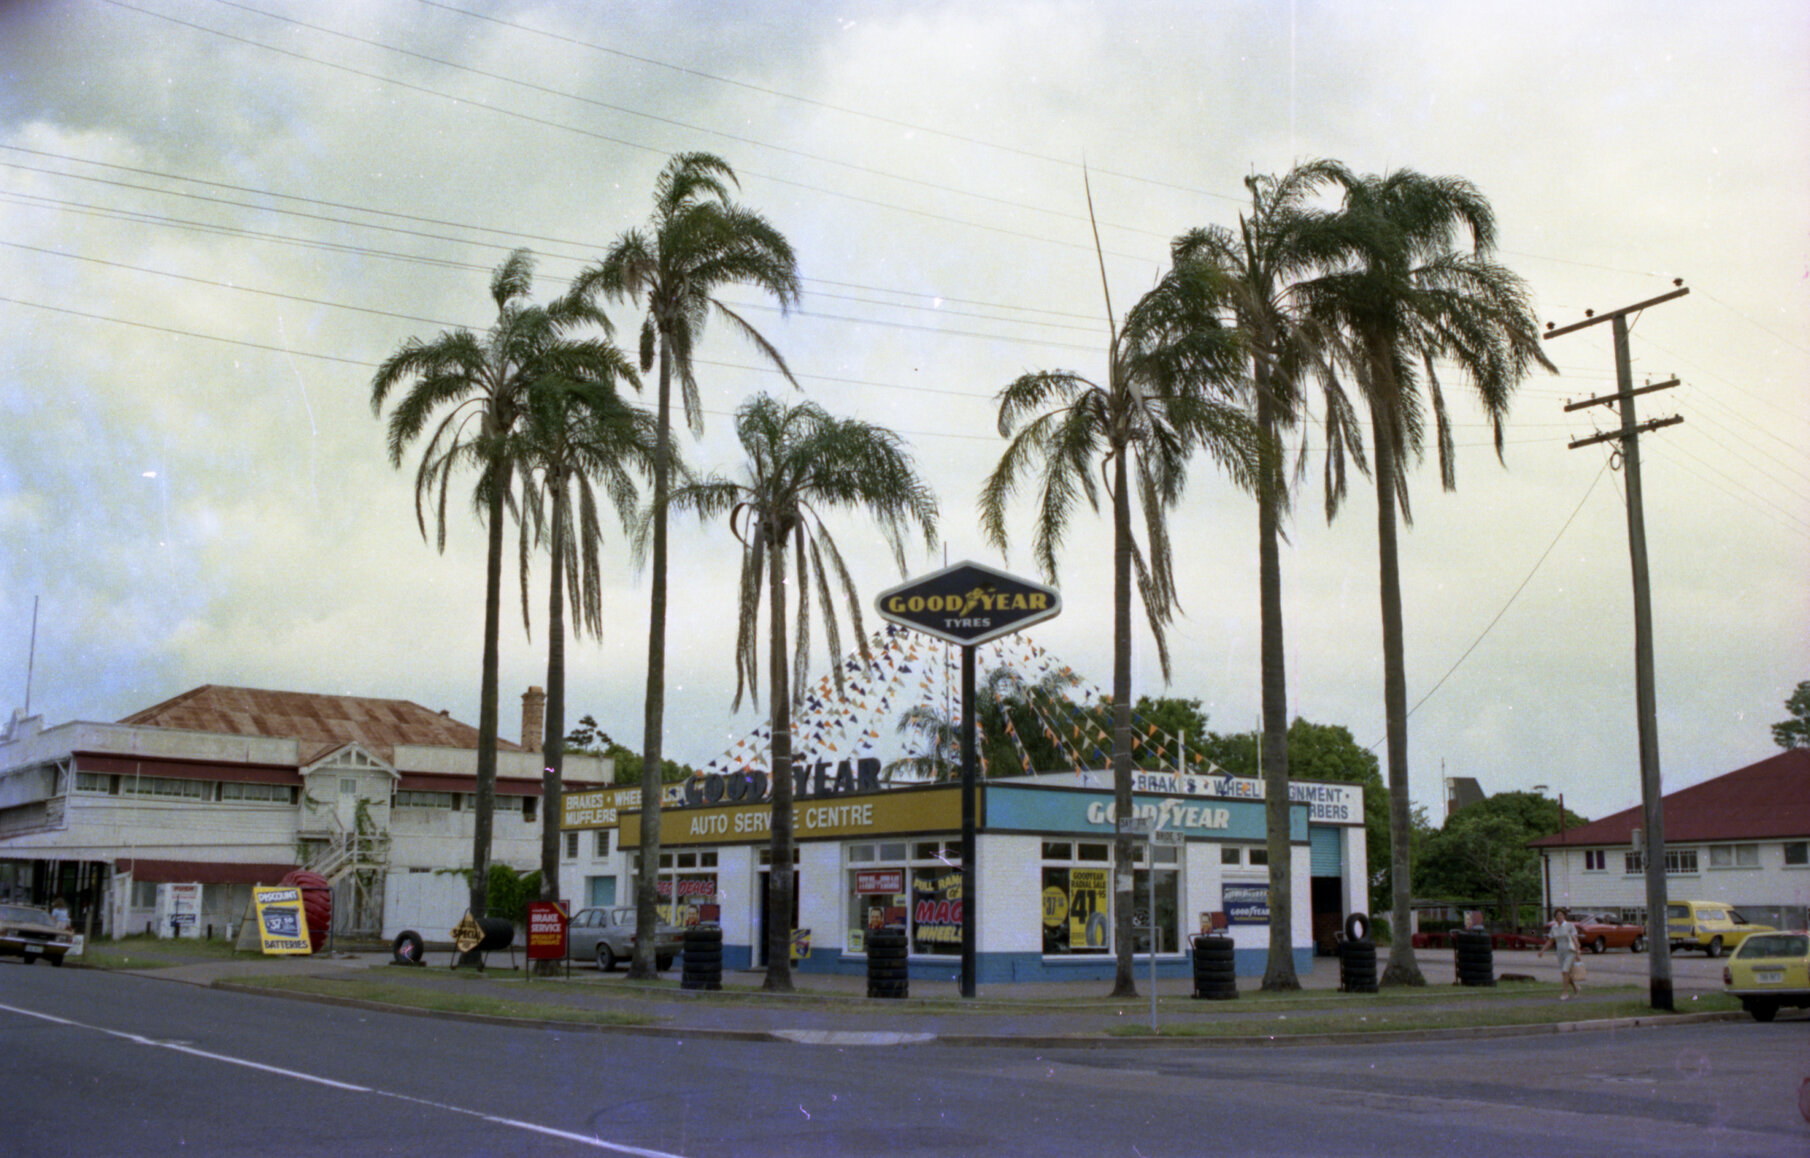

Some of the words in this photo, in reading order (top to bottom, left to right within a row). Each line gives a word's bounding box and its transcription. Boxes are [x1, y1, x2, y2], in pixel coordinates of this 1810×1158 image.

[888, 592, 1048, 614] GOODYEAR
[944, 617, 991, 628] TYRES
[1138, 775, 1196, 794] BRAKS
[1289, 784, 1342, 803] GNMENT
[565, 794, 603, 810] BRAKES
[614, 789, 642, 807] WHEE
[565, 809, 617, 825] MUFFLERS
[1310, 804, 1349, 820] RBERS
[690, 814, 728, 835] AUTO
[734, 811, 799, 832] SERVE
[805, 804, 874, 828] CENTRE
[1073, 872, 1104, 880] GOODYEAR
[678, 880, 714, 896] DEALS
[914, 878, 934, 892] FULL
[1071, 880, 1092, 888] RADIAL
[257, 890, 297, 903] DISCOUNT
[531, 913, 559, 924] BRAKE
[530, 923, 562, 934] SERVICE
[264, 940, 308, 950] BATTERIES
